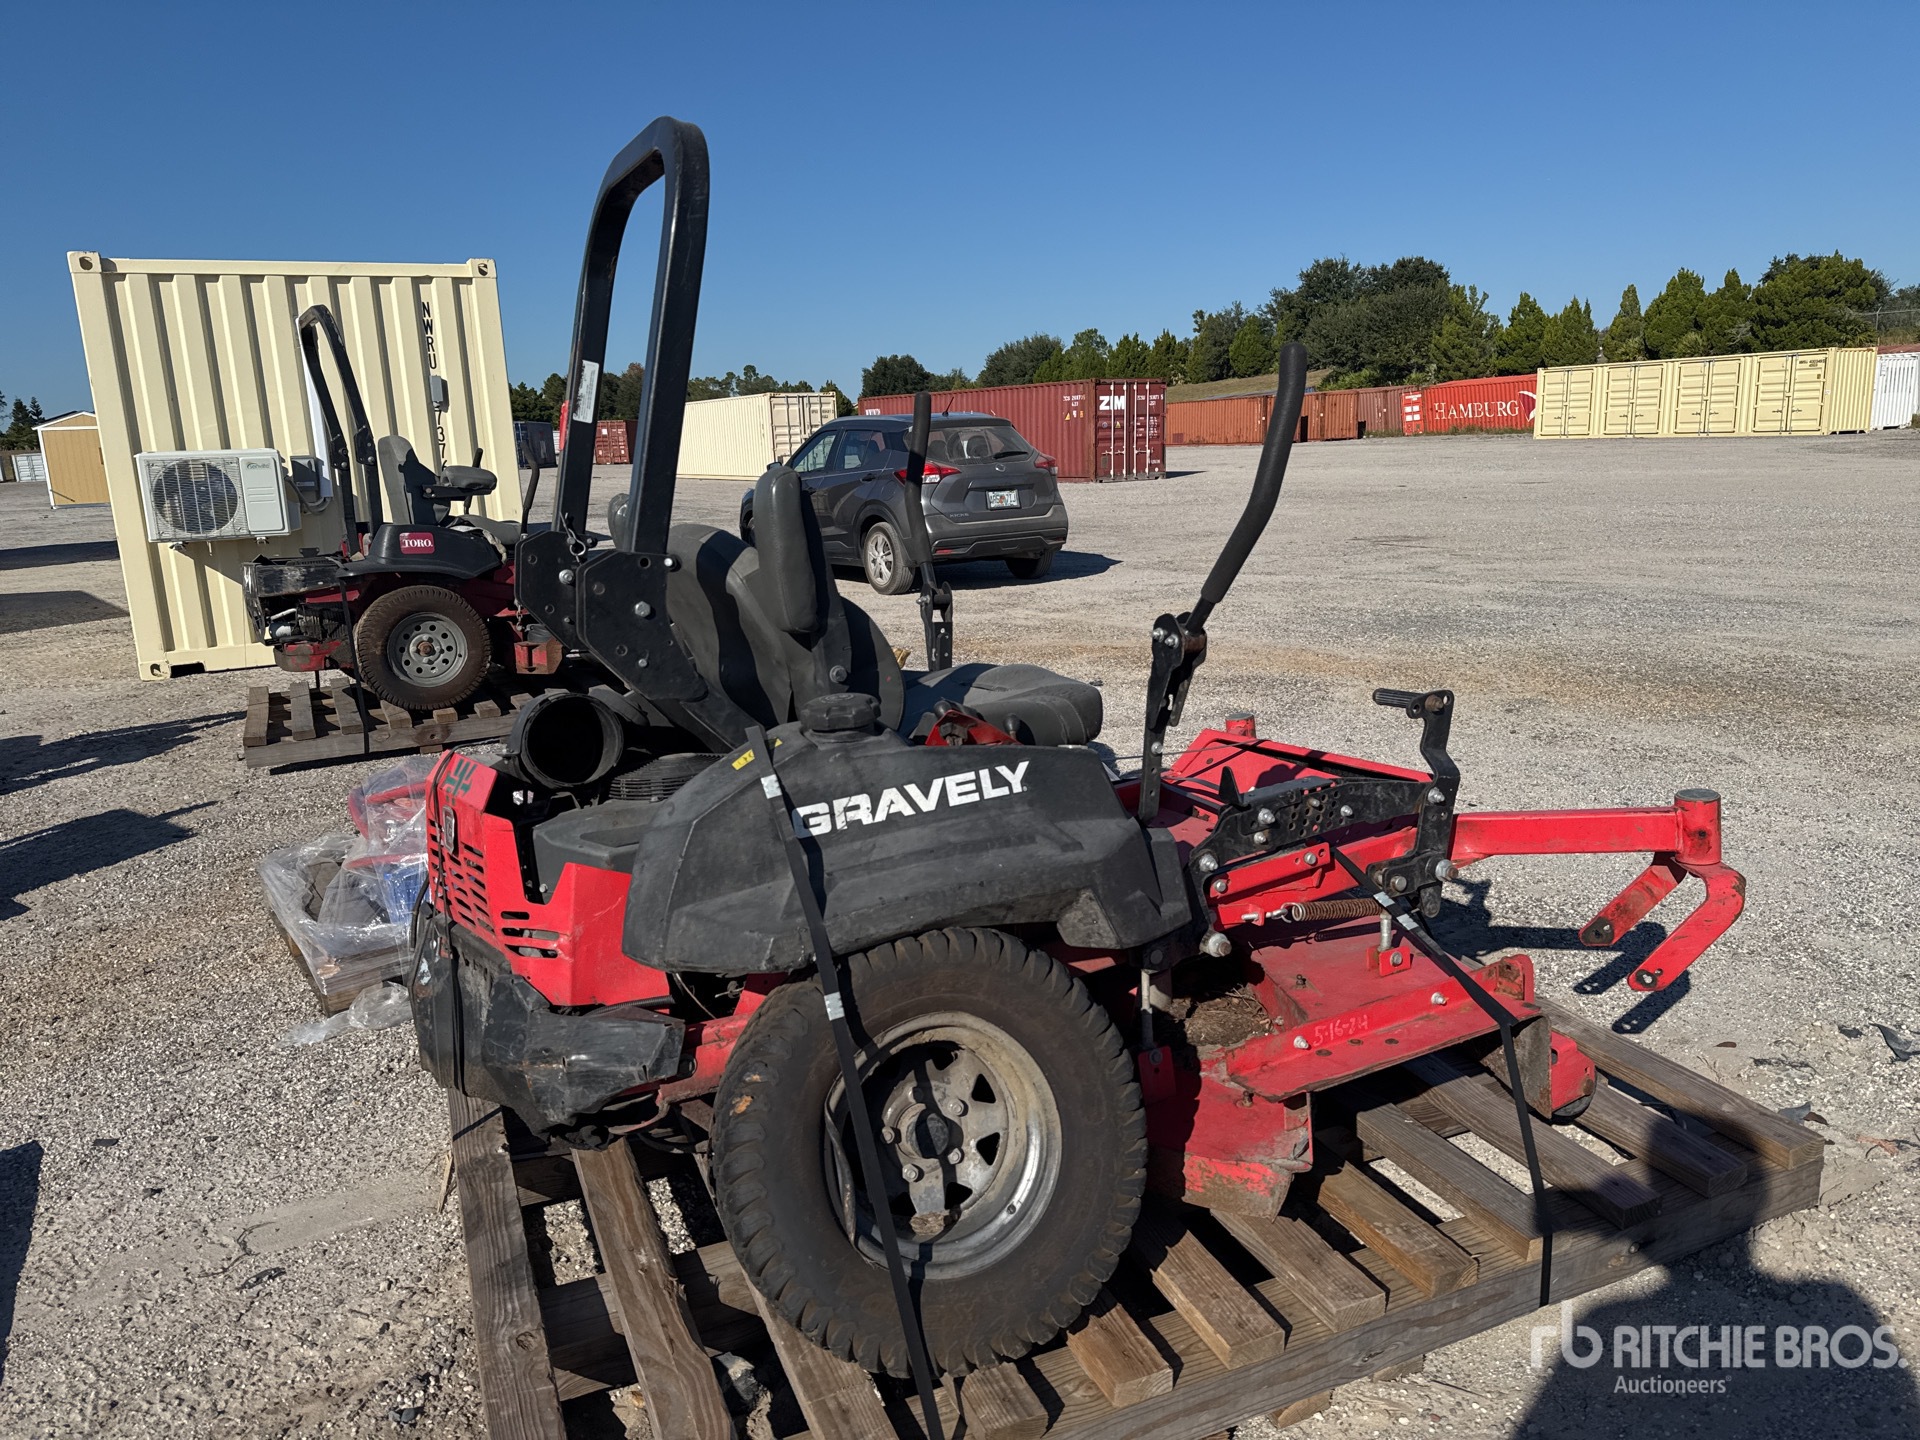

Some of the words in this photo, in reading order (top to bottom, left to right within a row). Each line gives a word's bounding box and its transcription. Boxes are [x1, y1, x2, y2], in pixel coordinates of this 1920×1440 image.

[421, 302, 437, 369] NWRU
[1099, 395, 1125, 410] ZIM
[1434, 400, 1520, 420] HAMBURG
[793, 761, 1029, 838] GRAVELY
